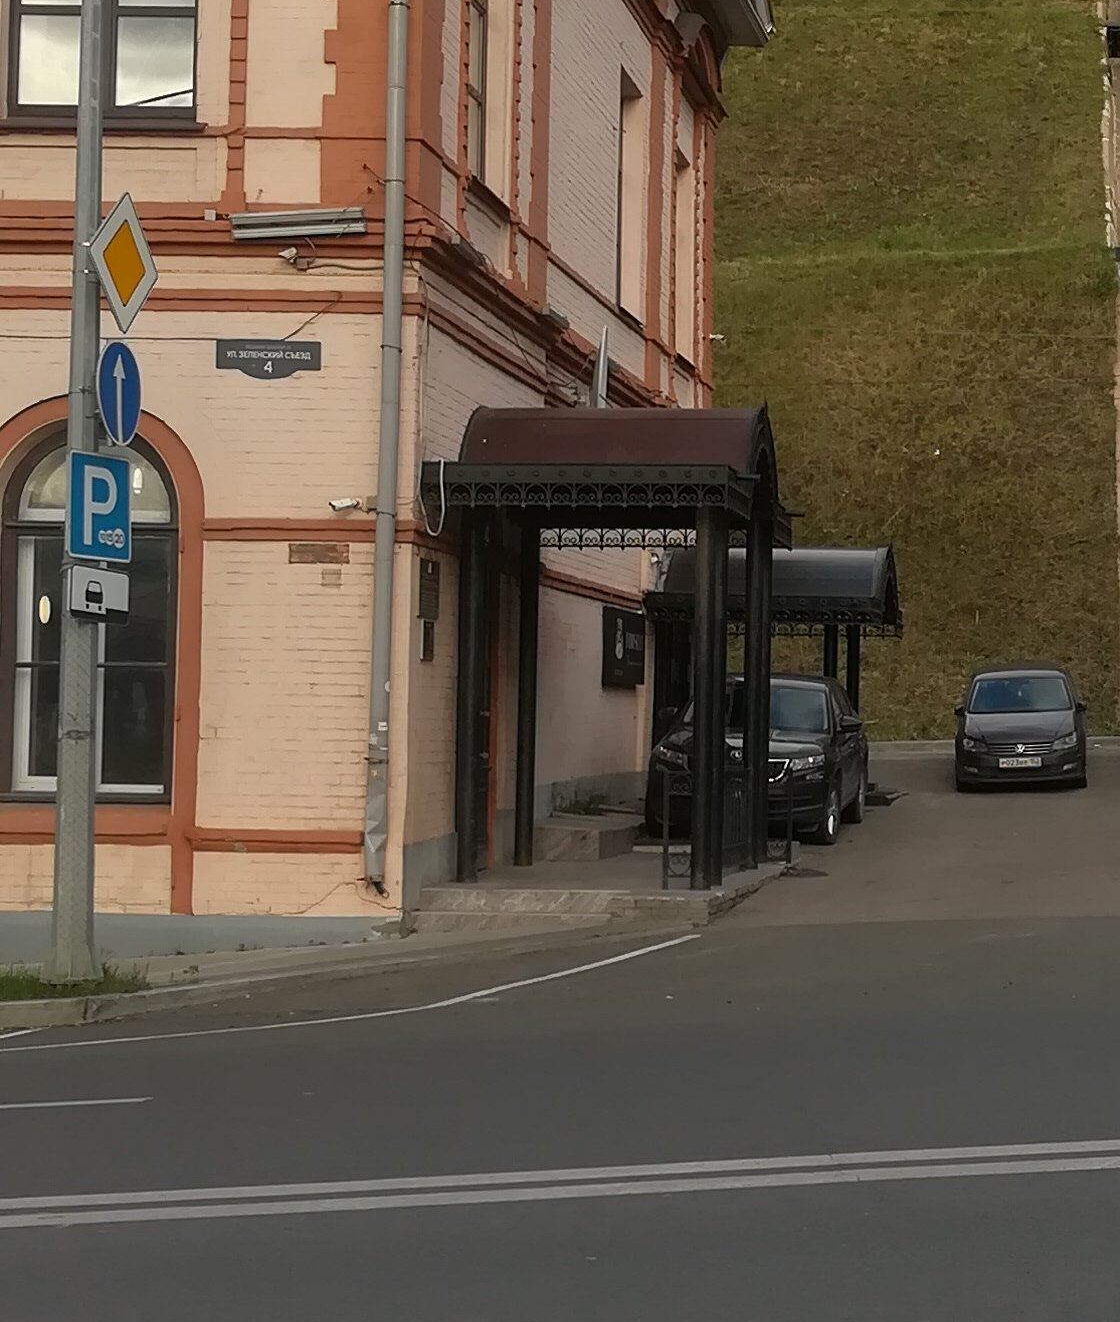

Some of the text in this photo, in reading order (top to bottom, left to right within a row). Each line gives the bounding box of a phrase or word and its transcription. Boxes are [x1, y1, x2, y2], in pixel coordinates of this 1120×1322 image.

[238, 349, 283, 359] ЗЕЛЕНСКИЙ
[284, 350, 311, 361] СЪЕЗД
[263, 360, 273, 374] 4
[83, 464, 118, 546] P
